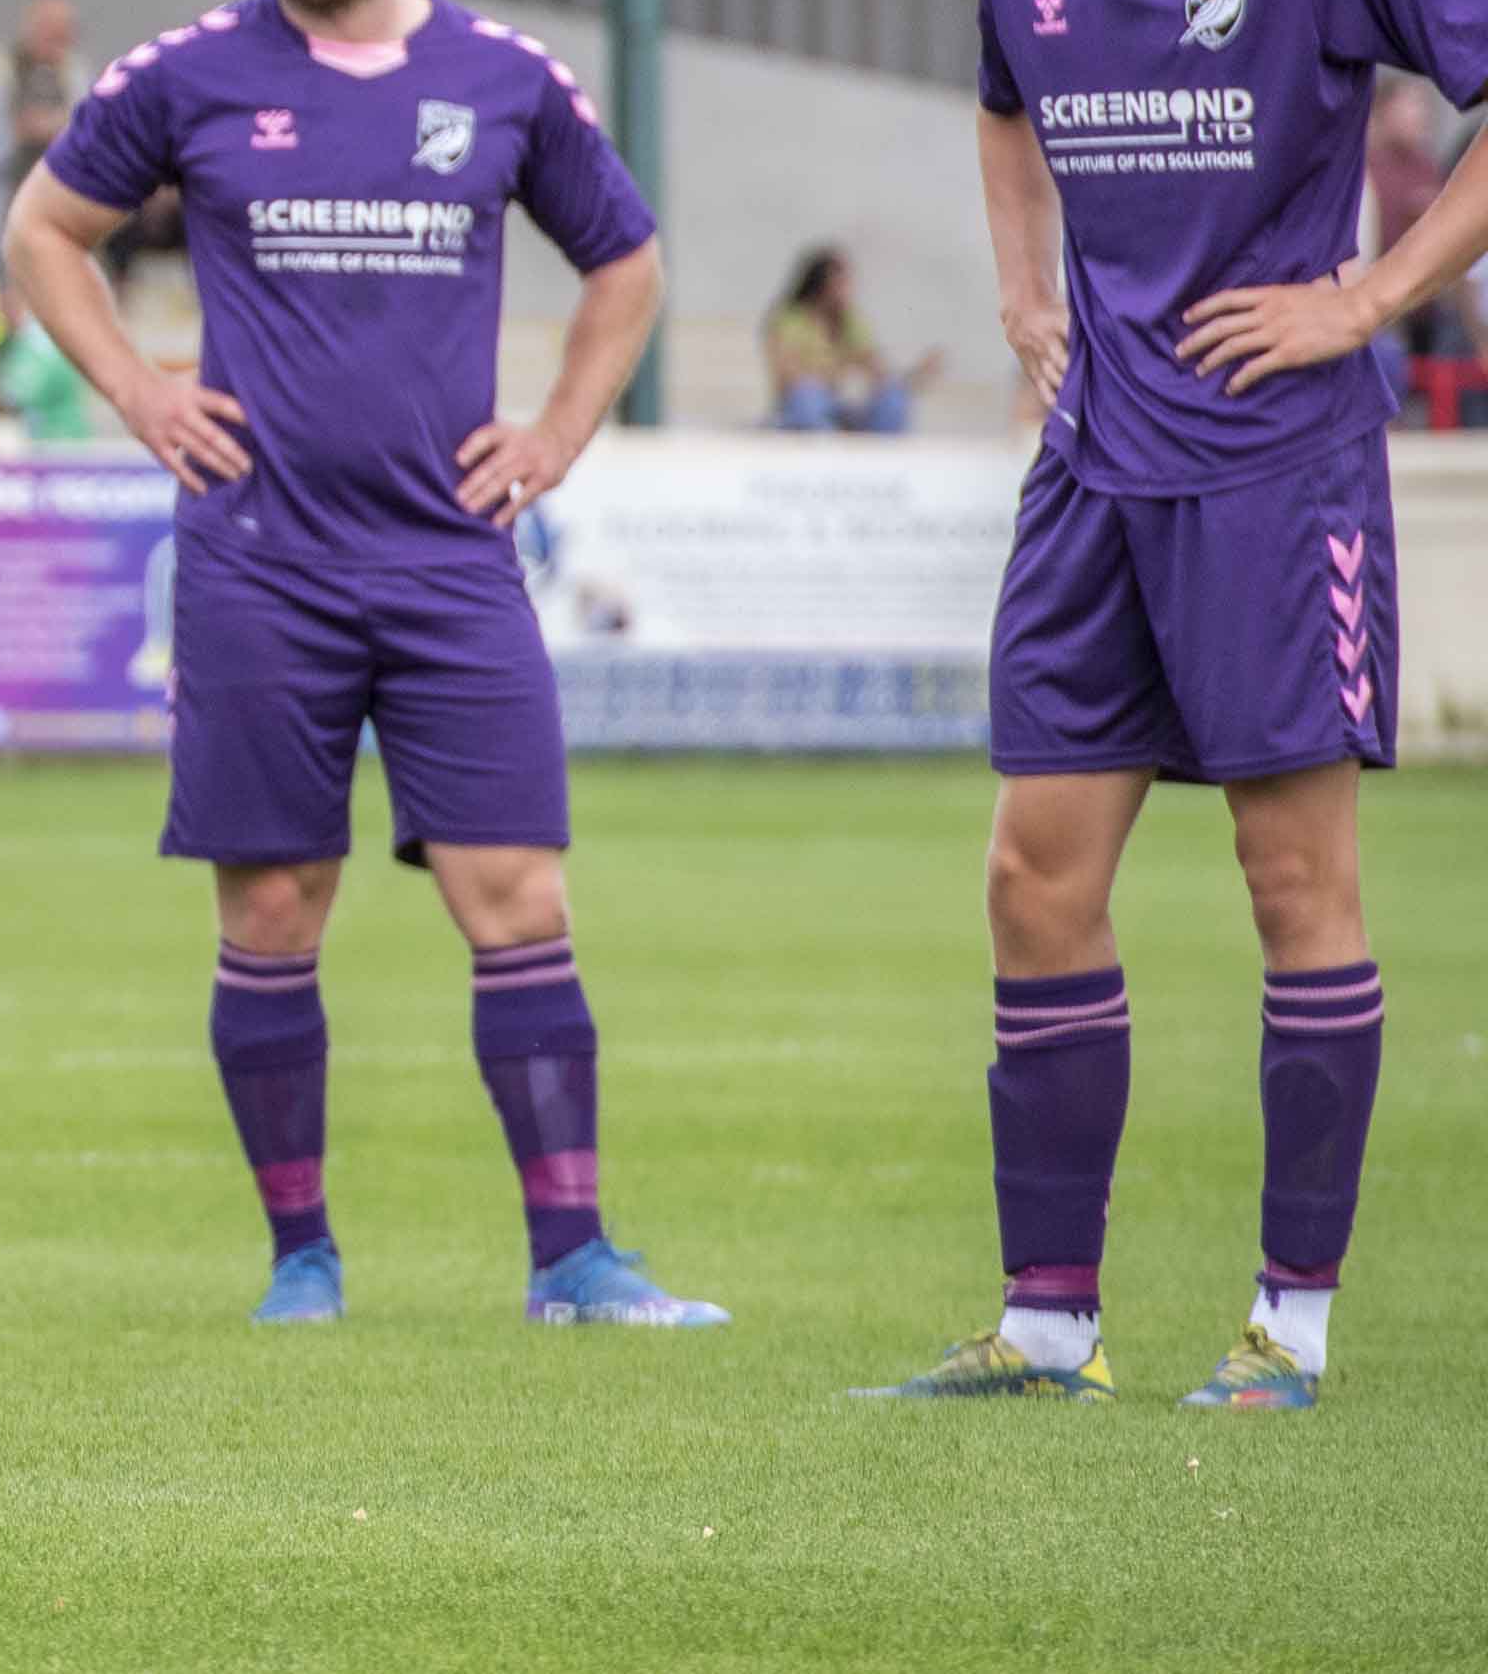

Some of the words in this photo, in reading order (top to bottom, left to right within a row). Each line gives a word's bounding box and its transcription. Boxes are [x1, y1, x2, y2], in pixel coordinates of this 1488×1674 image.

[1040, 88, 1253, 128] SCREENBOND
[1198, 122, 1254, 144] LTD
[1050, 156, 1068, 175] THE
[1070, 154, 1115, 174] FUTURE
[1117, 153, 1136, 172] OF
[1139, 152, 1165, 172] PCB
[1168, 150, 1254, 171] SOLUTIONS
[247, 199, 474, 233] SCREENBOND
[282, 252, 339, 273] FUTURE
[340, 253, 363, 273] OF
